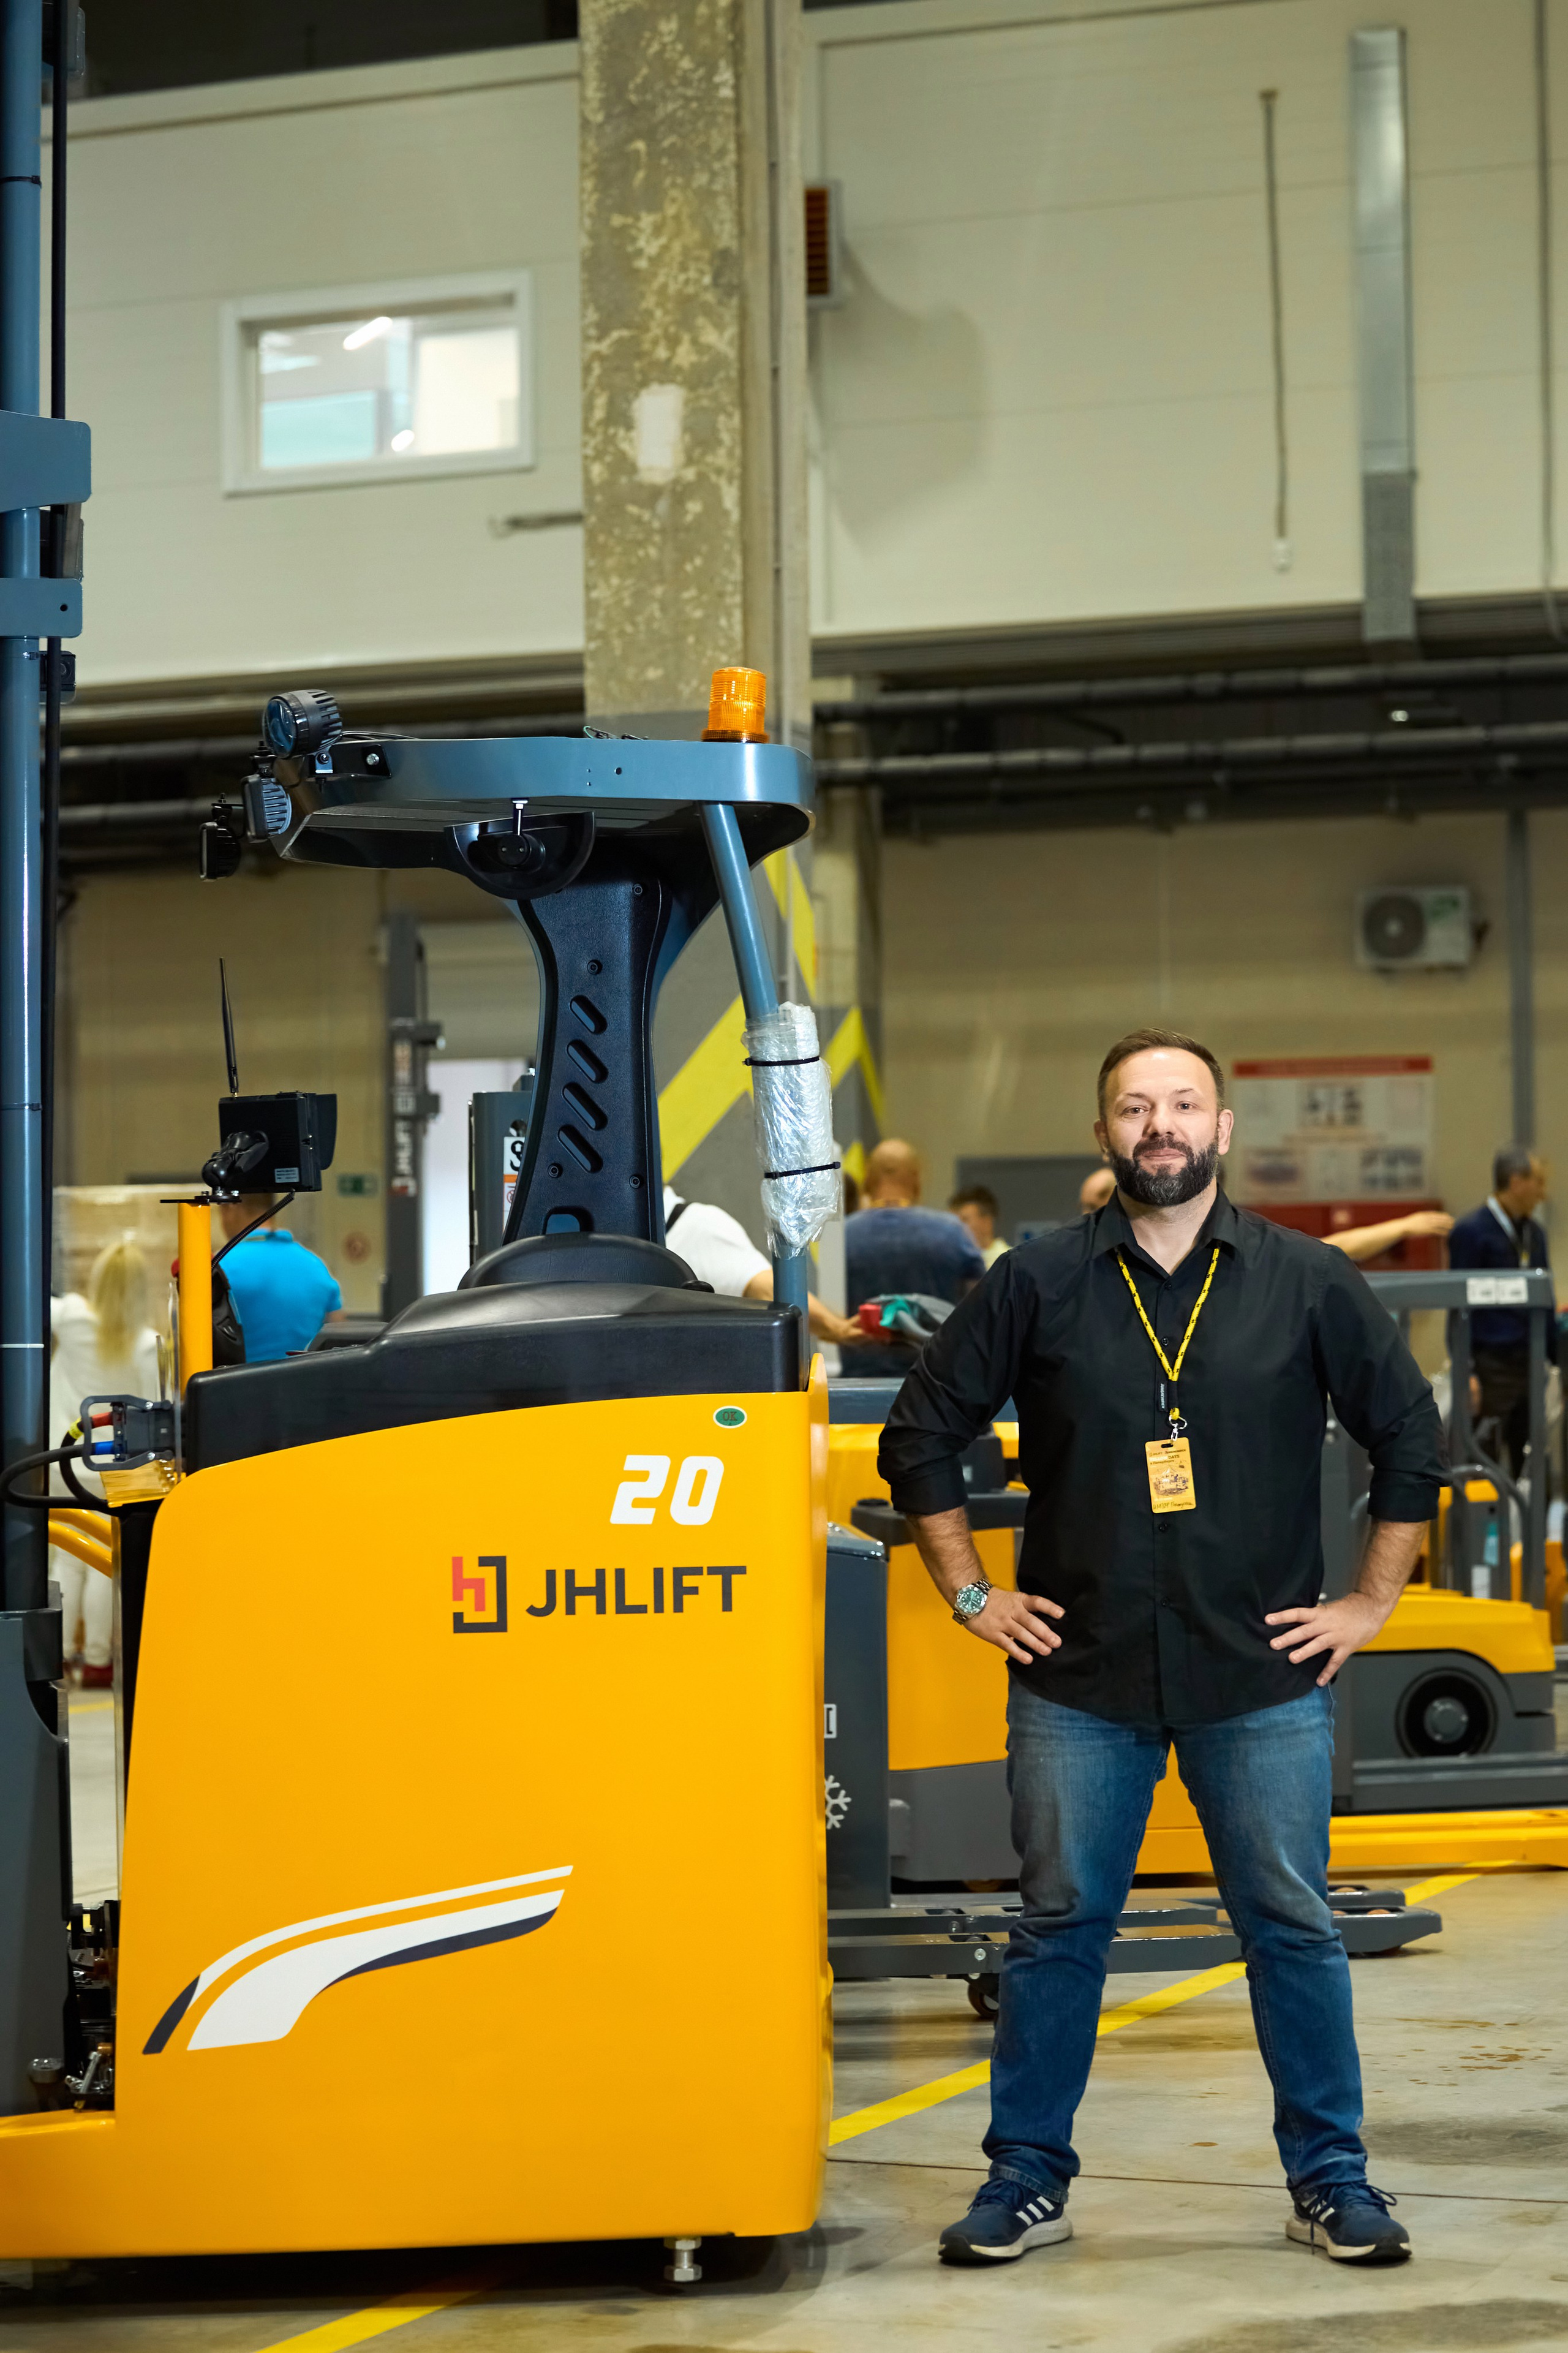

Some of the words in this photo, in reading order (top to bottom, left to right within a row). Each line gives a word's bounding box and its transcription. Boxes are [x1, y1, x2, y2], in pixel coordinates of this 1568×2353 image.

[722, 1411, 737, 1421] OK
[610, 1455, 725, 1525] 20
[526, 1565, 747, 1617] JHLIFT
